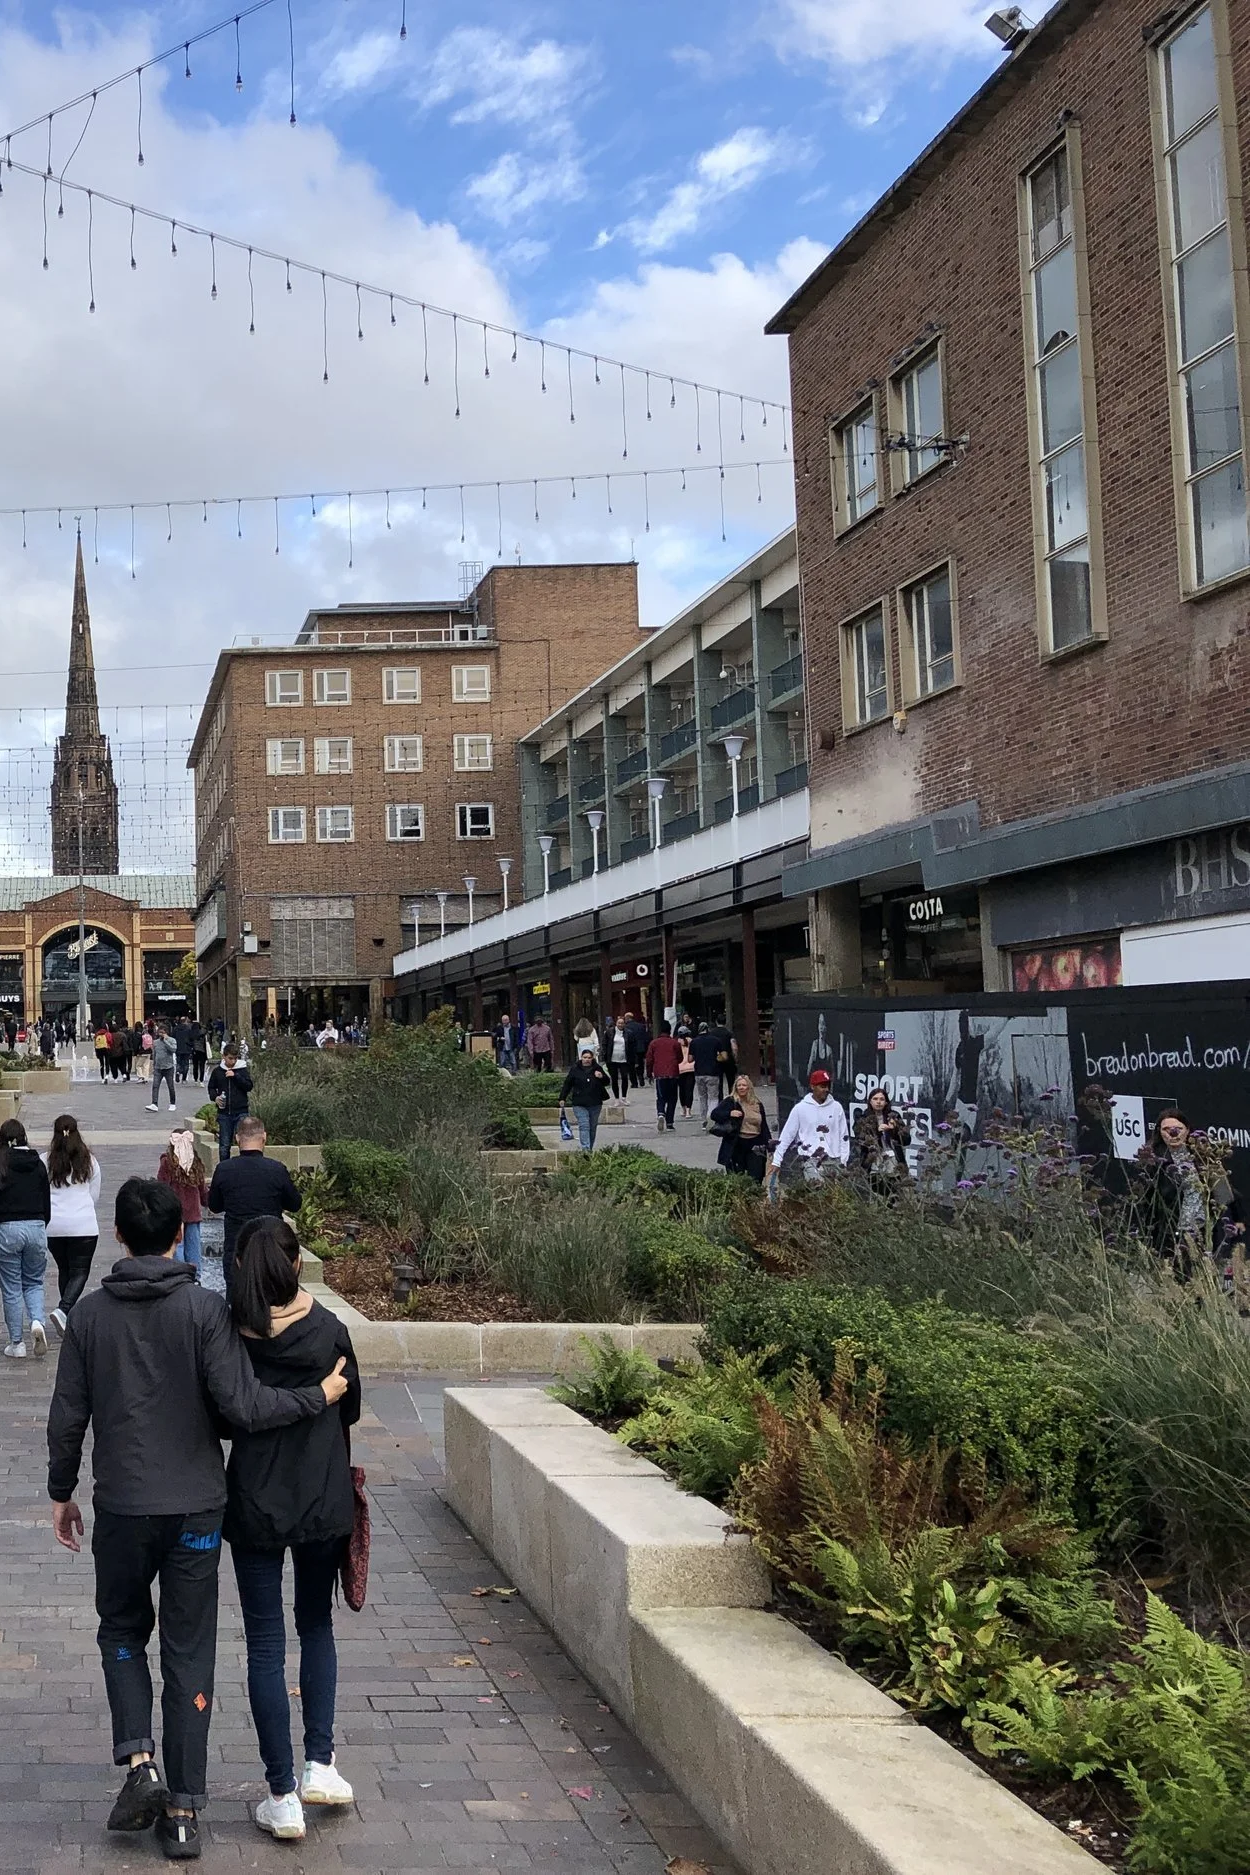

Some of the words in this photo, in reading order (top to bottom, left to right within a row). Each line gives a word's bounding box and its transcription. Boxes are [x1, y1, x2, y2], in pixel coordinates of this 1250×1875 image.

[1174, 828, 1250, 897] BHS
[909, 897, 944, 920] COSTA
[854, 1073, 924, 1103] SPORT
[1116, 1118, 1141, 1138] USC
